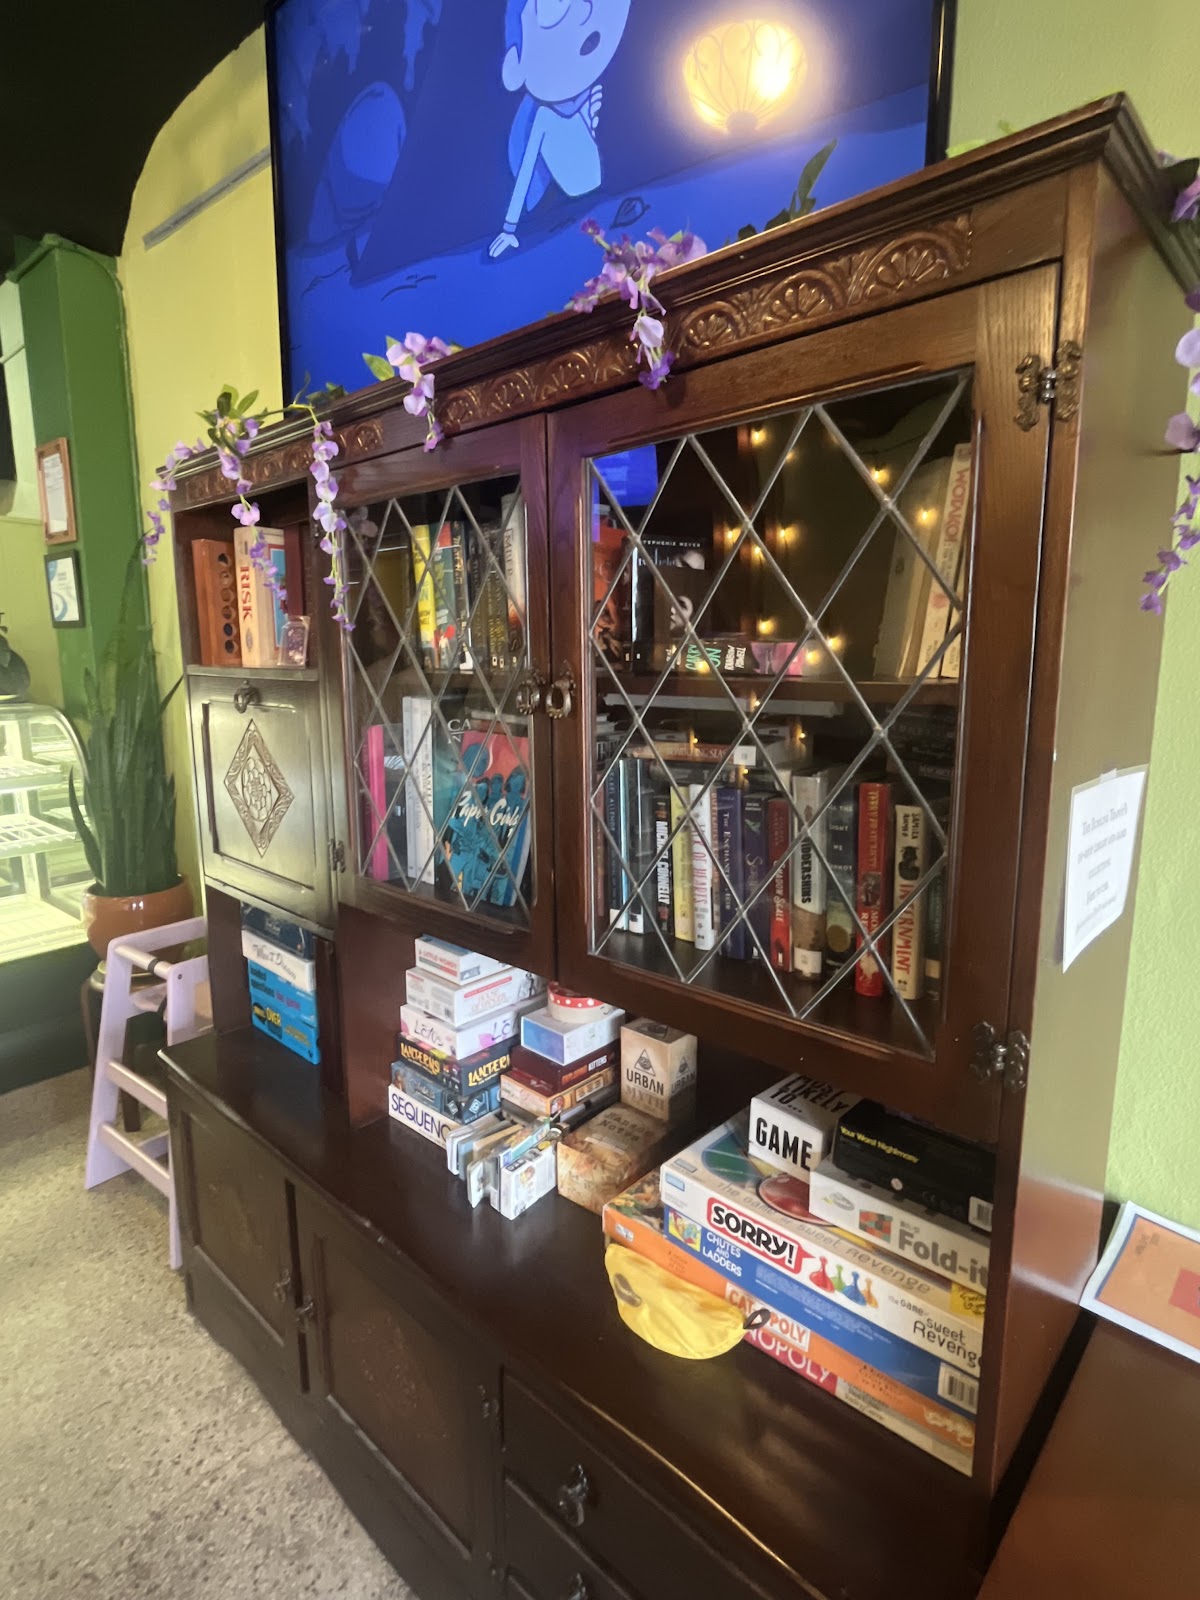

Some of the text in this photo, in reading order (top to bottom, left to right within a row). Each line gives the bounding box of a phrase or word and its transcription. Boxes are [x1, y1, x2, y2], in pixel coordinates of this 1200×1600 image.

[637, 547, 676, 568] twlight
[638, 539, 677, 548] TEPHENIE
[240, 566, 253, 620] RISK
[490, 798, 520, 827] Girls
[608, 799, 616, 832] ALLENDE
[829, 824, 849, 832] LIGHT
[656, 821, 670, 905] MICHAEL CONNELLY
[694, 852, 707, 865] OF
[693, 869, 708, 904] HEARTS
[773, 895, 786, 923] SCALE
[400, 1042, 440, 1075] LANTERNS
[468, 1054, 511, 1087] LANTER
[626, 1068, 664, 1096] URBAN
[671, 1070, 696, 1094] URBAN
[779, 1075, 849, 1114] LIKELY
[391, 1092, 451, 1143] SEQUENC
[840, 1125, 856, 1139] Your
[755, 1117, 813, 1172] GAME
[706, 1232, 741, 1258] CHUTES
[712, 1205, 795, 1266] SORRY!
[702, 1246, 742, 1277] LADDERS
[715, 1247, 729, 1259] AND
[728, 1289, 807, 1344] CATPOLY
[926, 1318, 967, 1346] sweet
[747, 1329, 831, 1383] OPOLY
